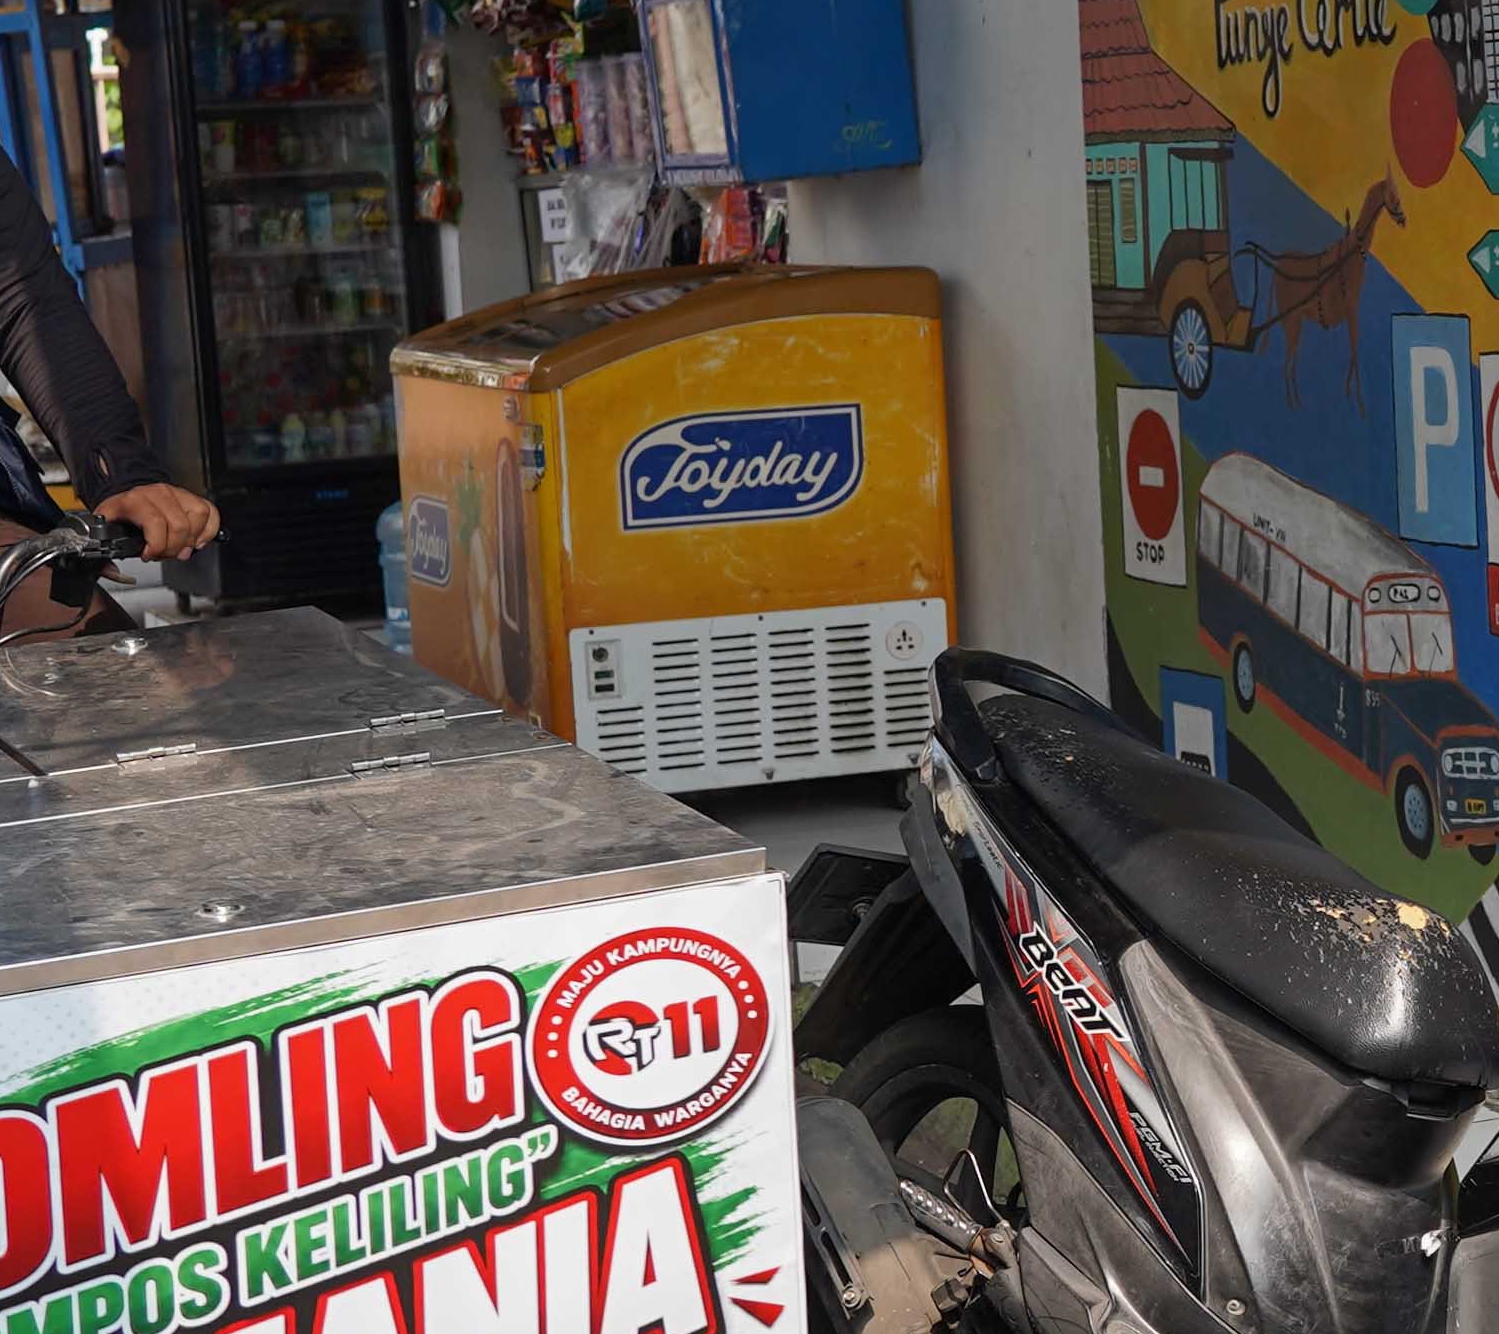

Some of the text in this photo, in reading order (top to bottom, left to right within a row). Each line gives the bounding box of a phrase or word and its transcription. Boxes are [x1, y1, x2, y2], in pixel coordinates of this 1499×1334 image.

[1409, 346, 1459, 514] P
[637, 438, 837, 508] Joyday
[1136, 541, 1165, 565] STOP
[556, 937, 742, 1008] MAJU KAMPUNGNYA
[663, 995, 721, 1059] 11
[562, 1051, 752, 1130] BAHAGIA WARGANYA
